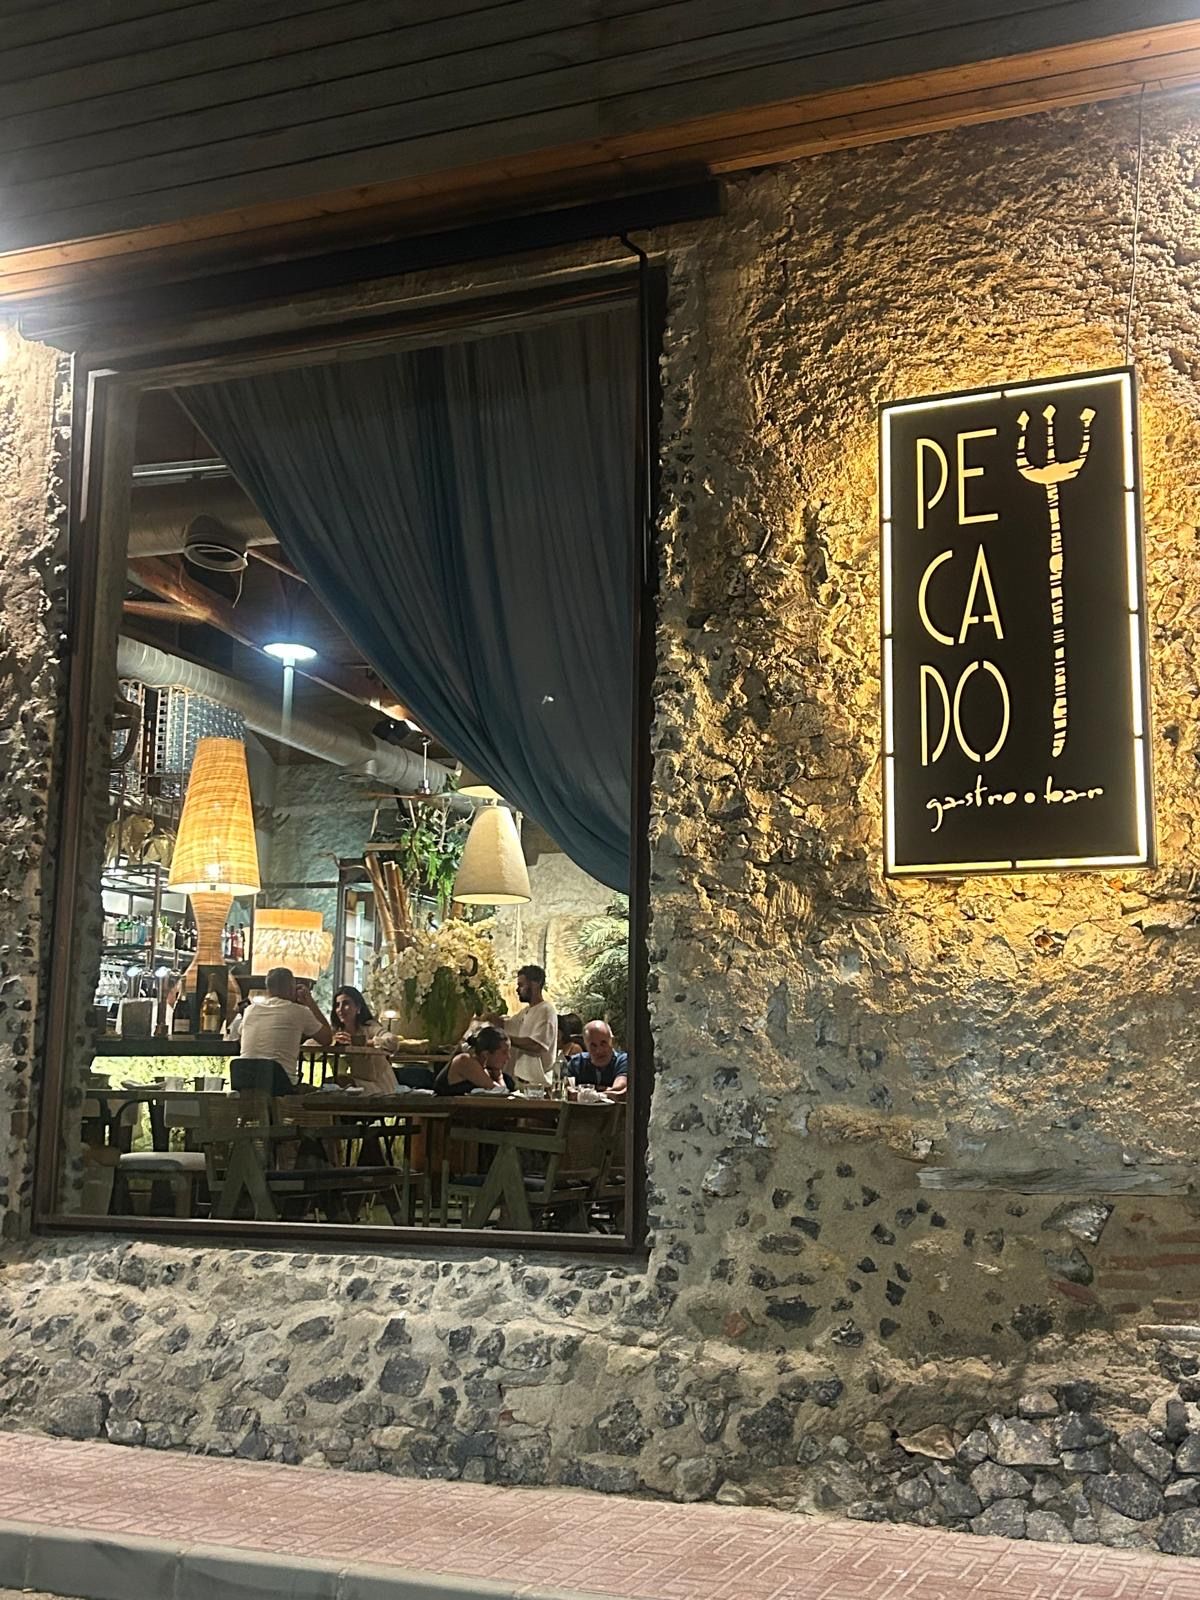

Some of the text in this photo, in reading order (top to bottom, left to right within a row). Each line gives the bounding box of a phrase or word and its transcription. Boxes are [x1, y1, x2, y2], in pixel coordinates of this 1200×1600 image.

[916, 428, 999, 530] PE
[918, 543, 1004, 646] CA
[920, 660, 1010, 767] DO
[926, 774, 1104, 833] gastro bar
